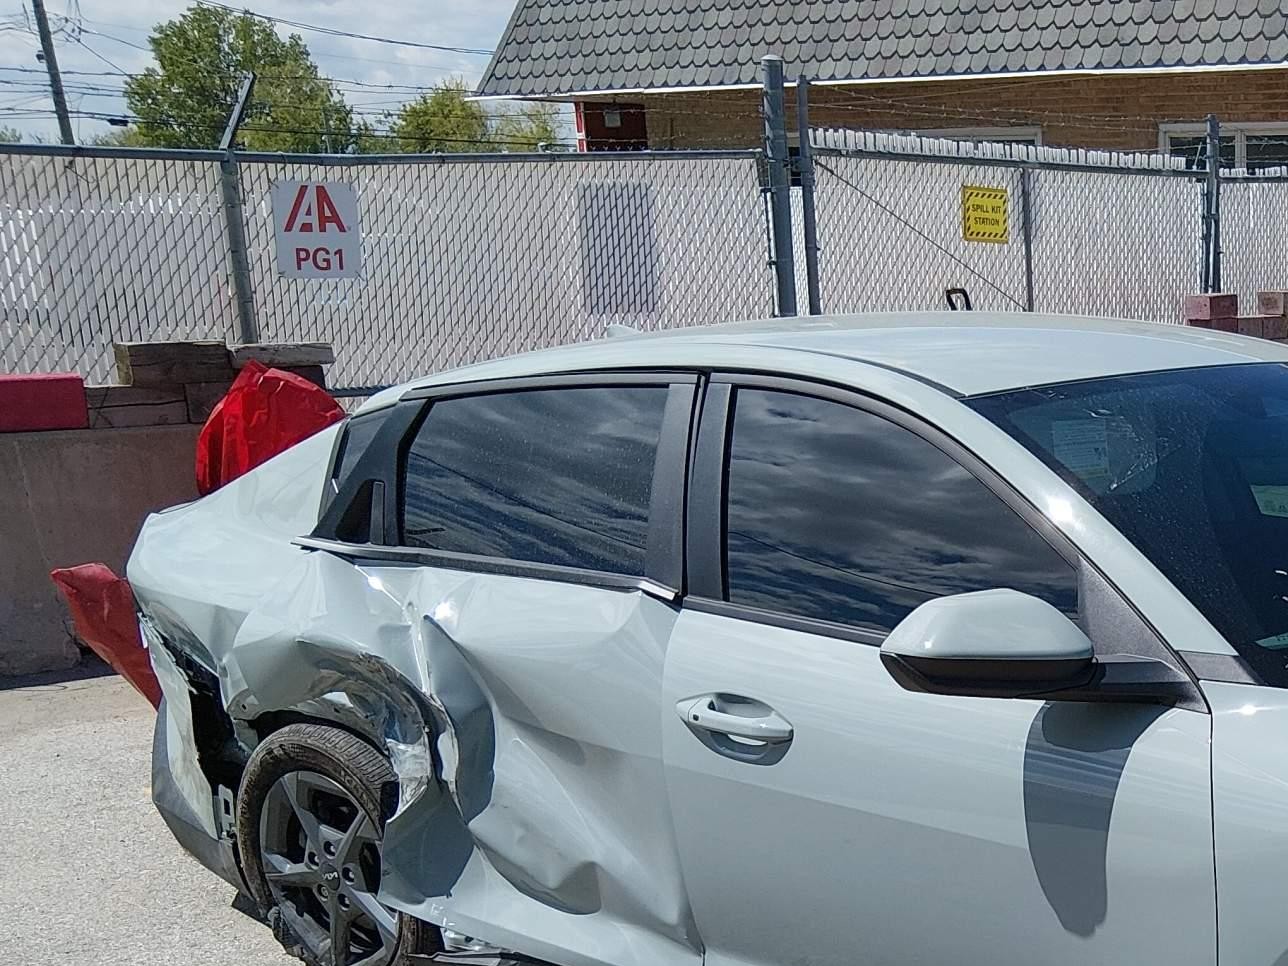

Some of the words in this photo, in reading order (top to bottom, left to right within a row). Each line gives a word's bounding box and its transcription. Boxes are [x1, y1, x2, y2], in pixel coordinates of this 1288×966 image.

[971, 204, 989, 213] SPILL
[991, 205, 1001, 214] KIT
[974, 217, 1000, 226] STATION
[295, 247, 344, 271] PG1
